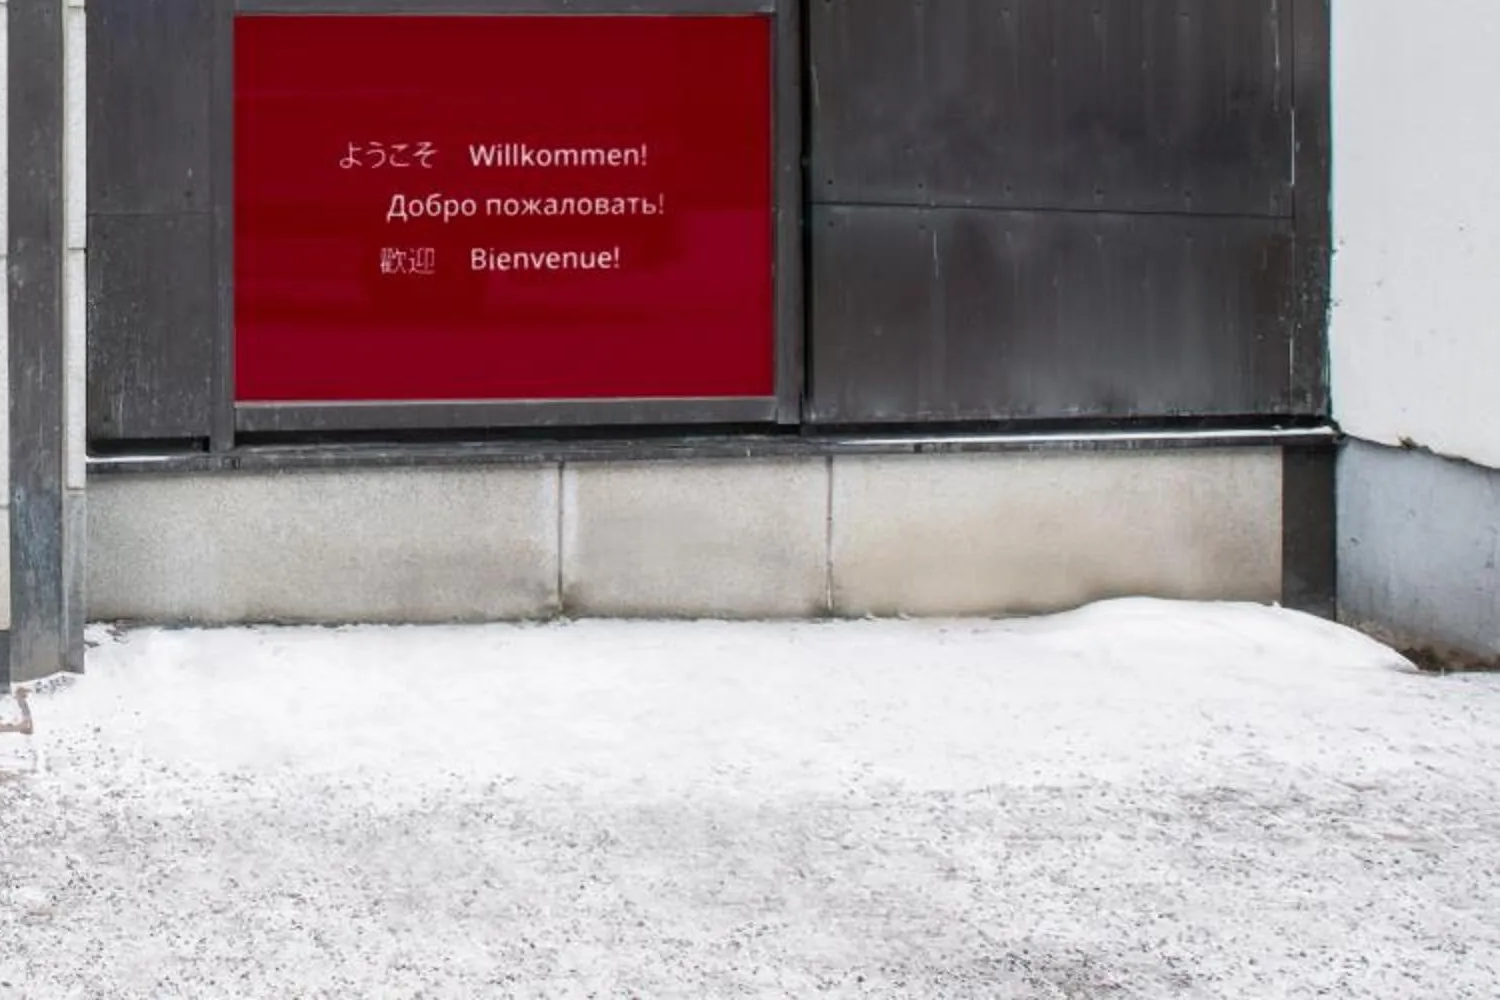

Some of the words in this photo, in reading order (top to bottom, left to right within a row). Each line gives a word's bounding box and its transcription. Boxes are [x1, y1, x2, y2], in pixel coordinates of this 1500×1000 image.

[339, 141, 438, 169] ようこそ
[469, 143, 648, 168] Willkommen!
[386, 193, 477, 223] Добро
[485, 193, 665, 216] пожаловать!
[471, 246, 621, 271] Bienvenue!
